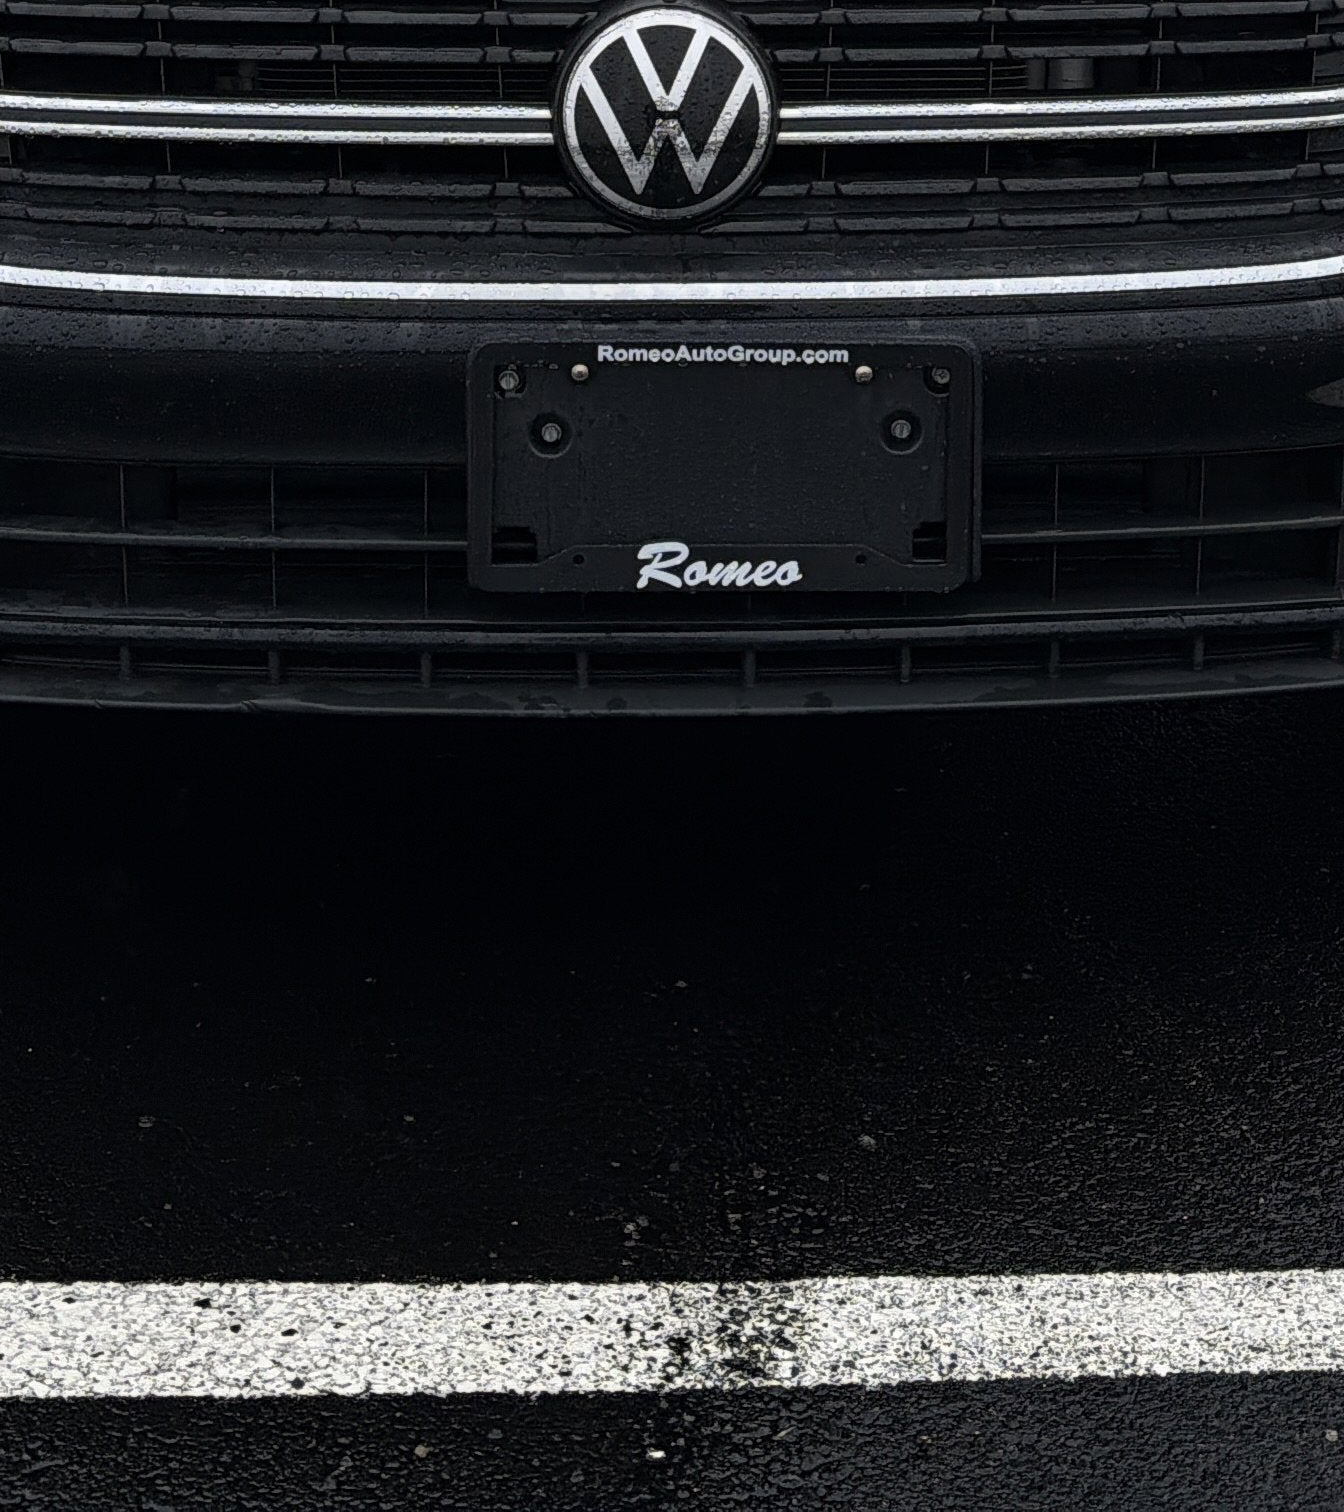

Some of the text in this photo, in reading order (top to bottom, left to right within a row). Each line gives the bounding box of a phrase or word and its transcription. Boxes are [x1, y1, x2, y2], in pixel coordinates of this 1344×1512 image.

[576, 24, 756, 195] VW
[597, 345, 849, 365] RomeoAutoGroup.com
[636, 541, 803, 589] Romeo
